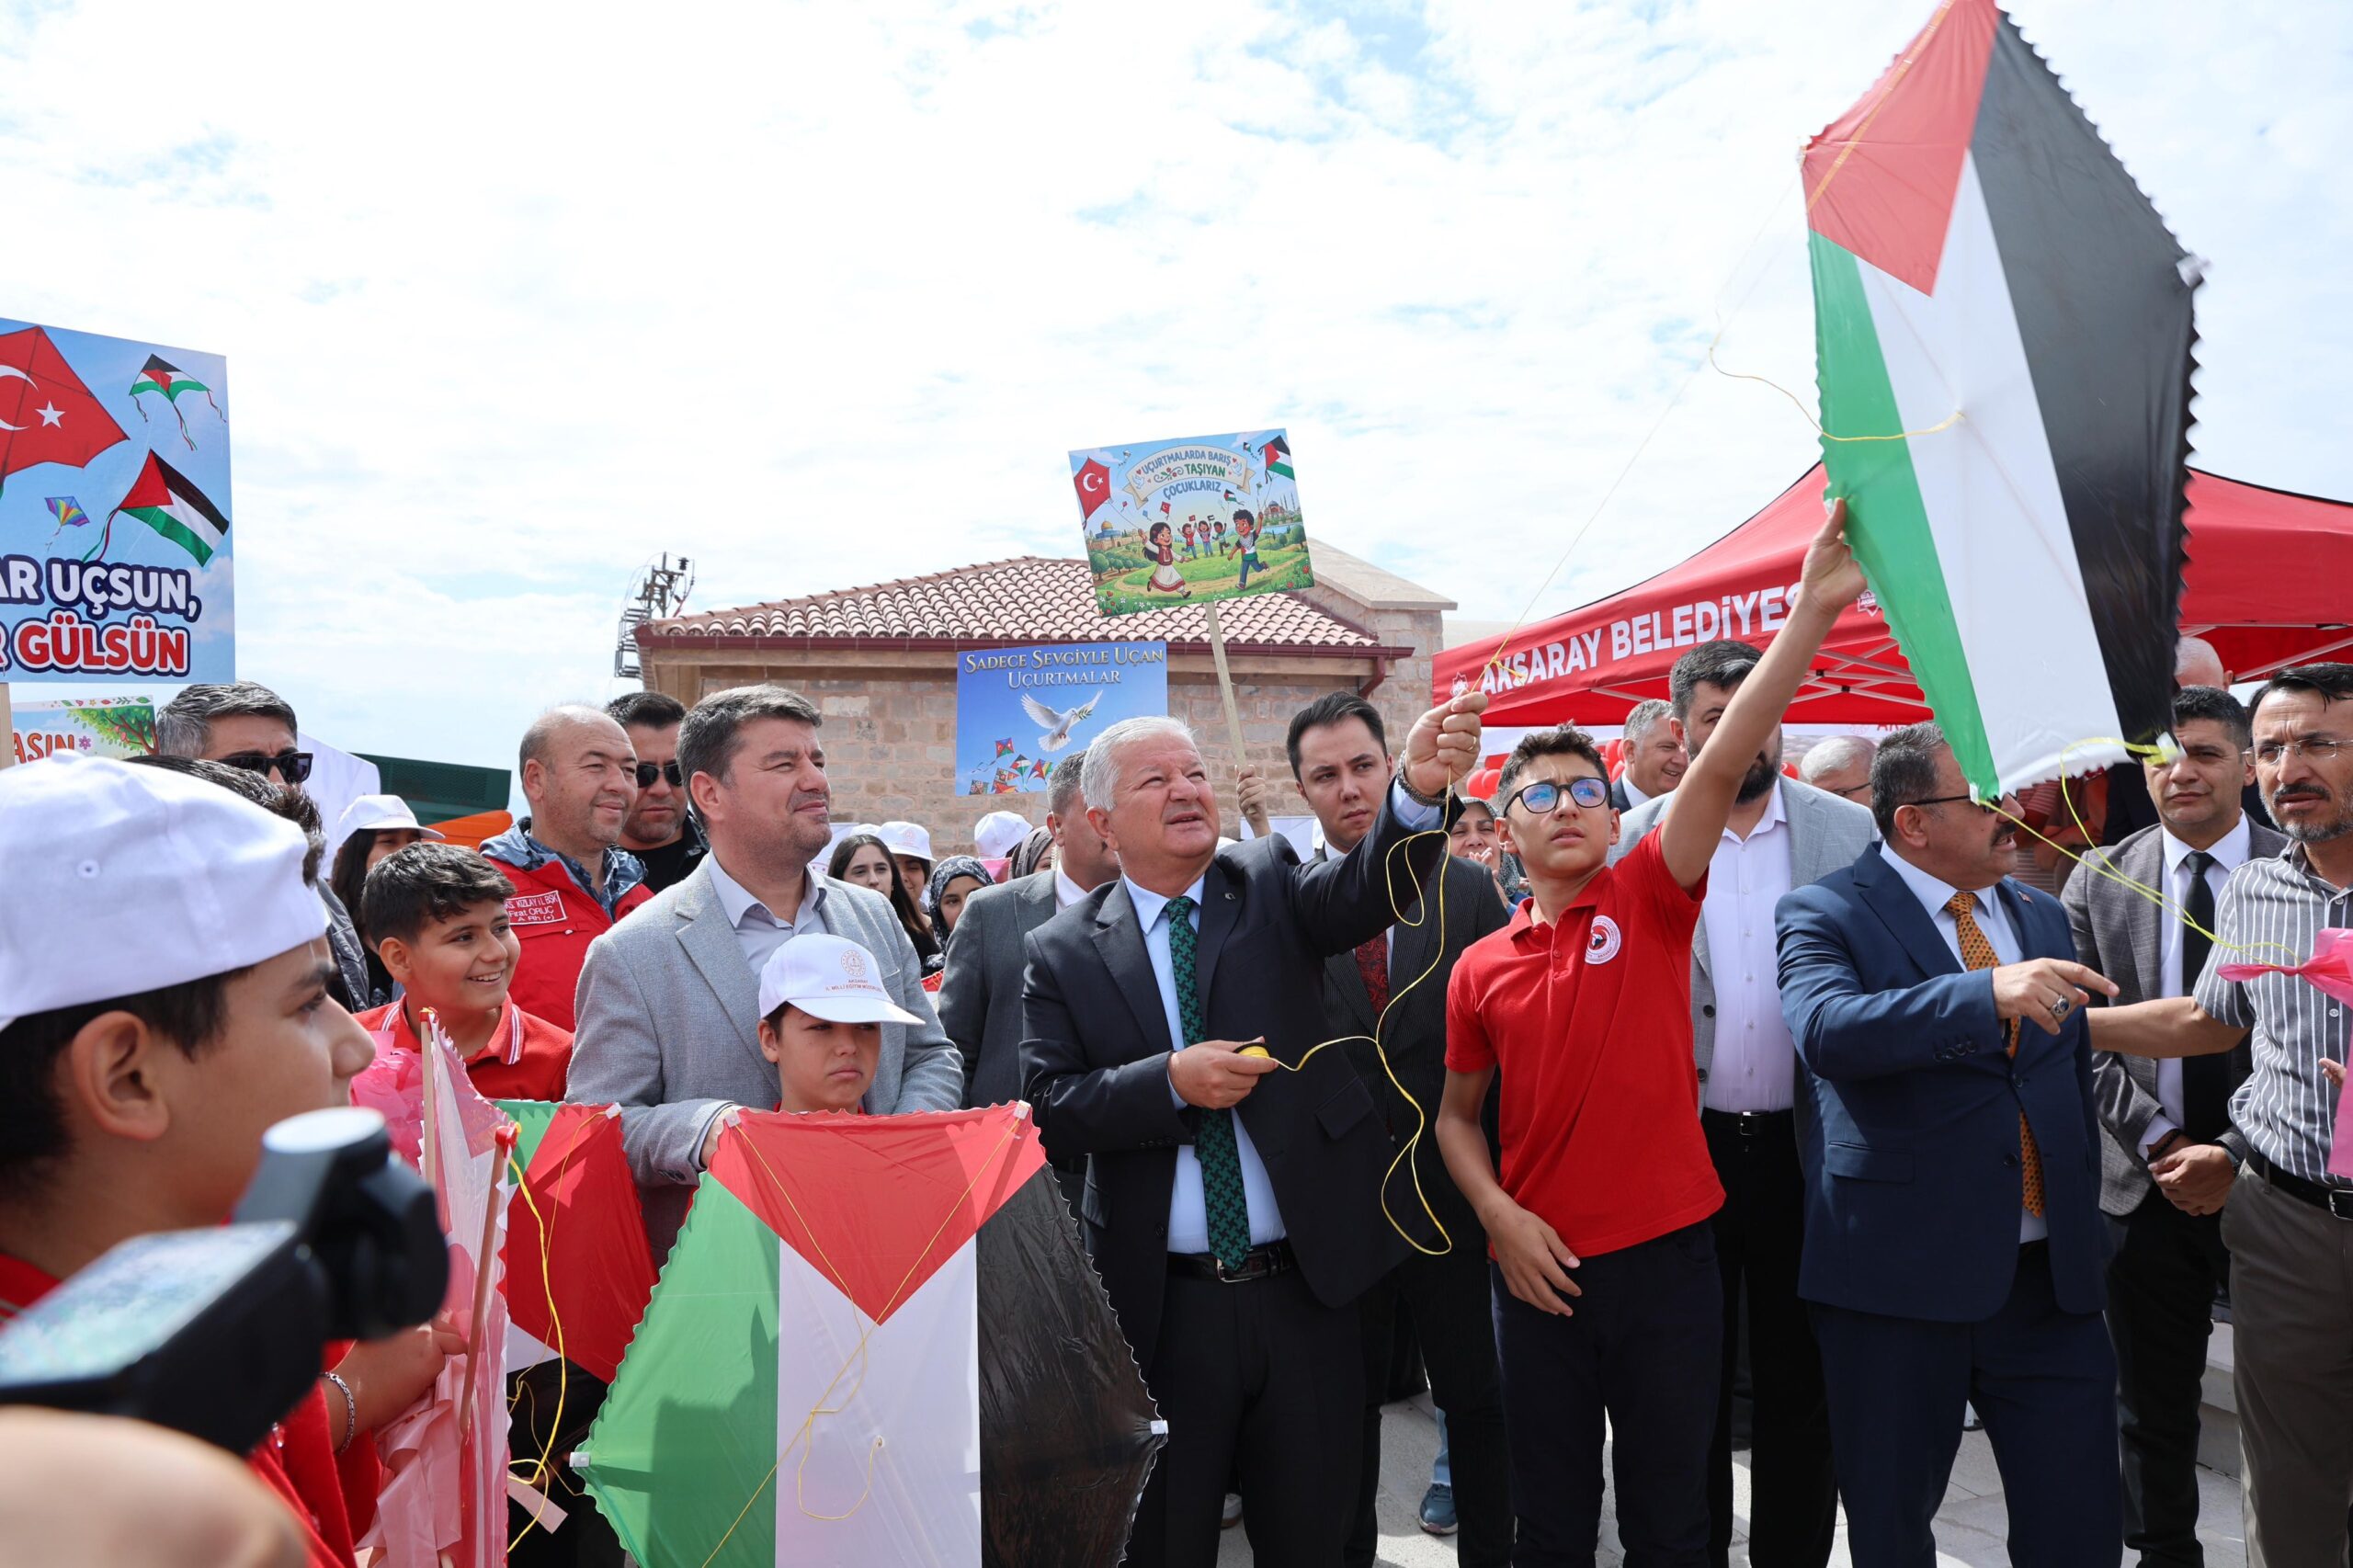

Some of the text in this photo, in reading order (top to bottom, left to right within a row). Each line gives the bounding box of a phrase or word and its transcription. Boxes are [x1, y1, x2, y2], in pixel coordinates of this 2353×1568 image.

[1142, 450, 1232, 474] UÇURTMALARDA BARIŞ
[1184, 463, 1226, 477] TAŞIYAN
[1163, 480, 1222, 500] ÇOCUKLARIZ
[51, 562, 199, 618] UÇSUN,
[17, 613, 187, 671] GÜLSÜN
[1481, 582, 1802, 695] AKSARAY BELEDİYE
[1008, 669, 1121, 689] UÇURTMALAR
